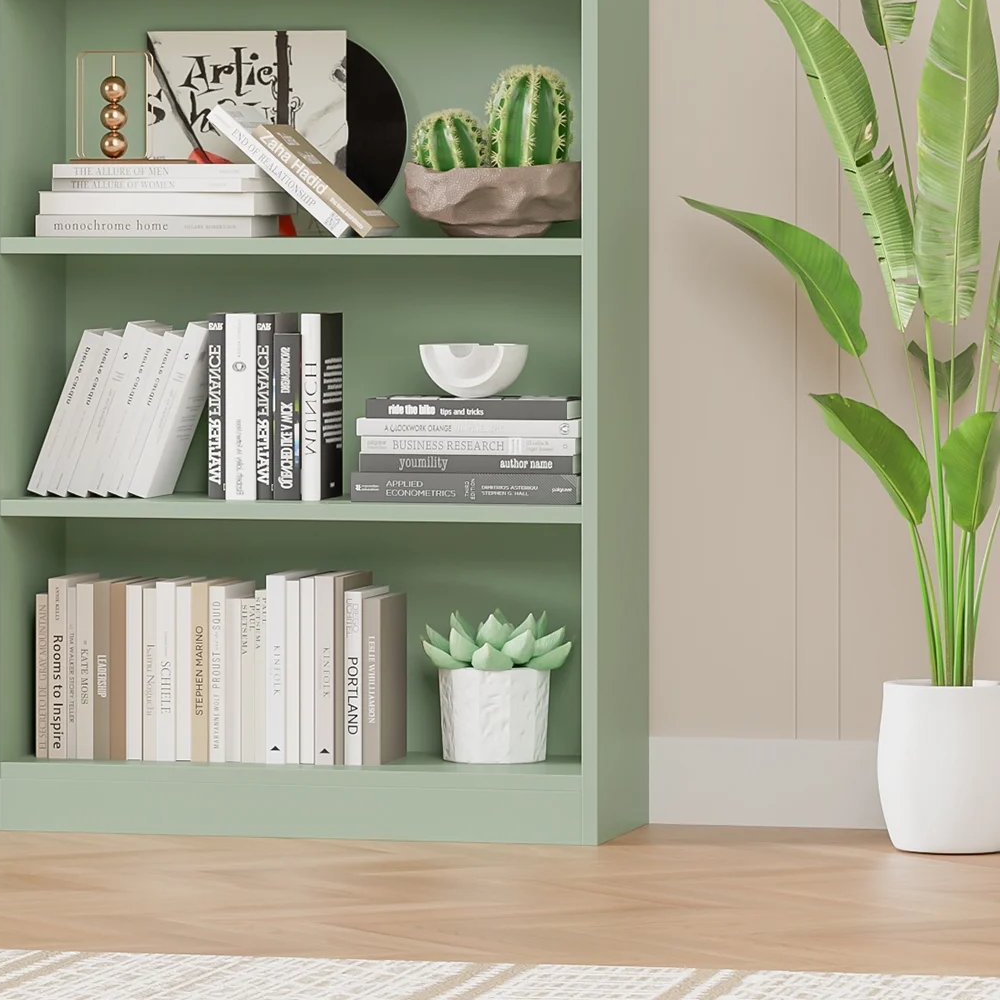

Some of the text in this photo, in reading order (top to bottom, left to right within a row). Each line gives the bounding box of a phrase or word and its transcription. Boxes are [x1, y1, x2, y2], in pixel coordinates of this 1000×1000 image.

[231, 129, 247, 142] END
[248, 141, 261, 154] OF
[74, 167, 169, 176] THE ALLURE OF MEN
[258, 133, 329, 195] Zaha Hadid
[71, 181, 175, 189] THE ALLURE OF WOMEN
[53, 219, 169, 231] monochrome home
[388, 405, 404, 415] ride
[405, 405, 418, 415] the
[419, 405, 436, 415] bike
[440, 408, 452, 416] tips
[467, 408, 484, 416] tricks
[392, 440, 444, 450] BUSINESS
[447, 441, 504, 451] RESEARCH
[399, 456, 448, 471] youmility
[500, 459, 553, 469] author name
[386, 489, 456, 497] ECONOMETRICS
[80, 649, 88, 704] KATE MOSS
[97, 654, 107, 698] LEADERSHIP
[195, 625, 203, 715] STEPHEN MARINO
[50, 635, 63, 749] Rooms to Inspire
[160, 661, 171, 714] SCHIELE
[347, 657, 358, 735] PORTLAND
